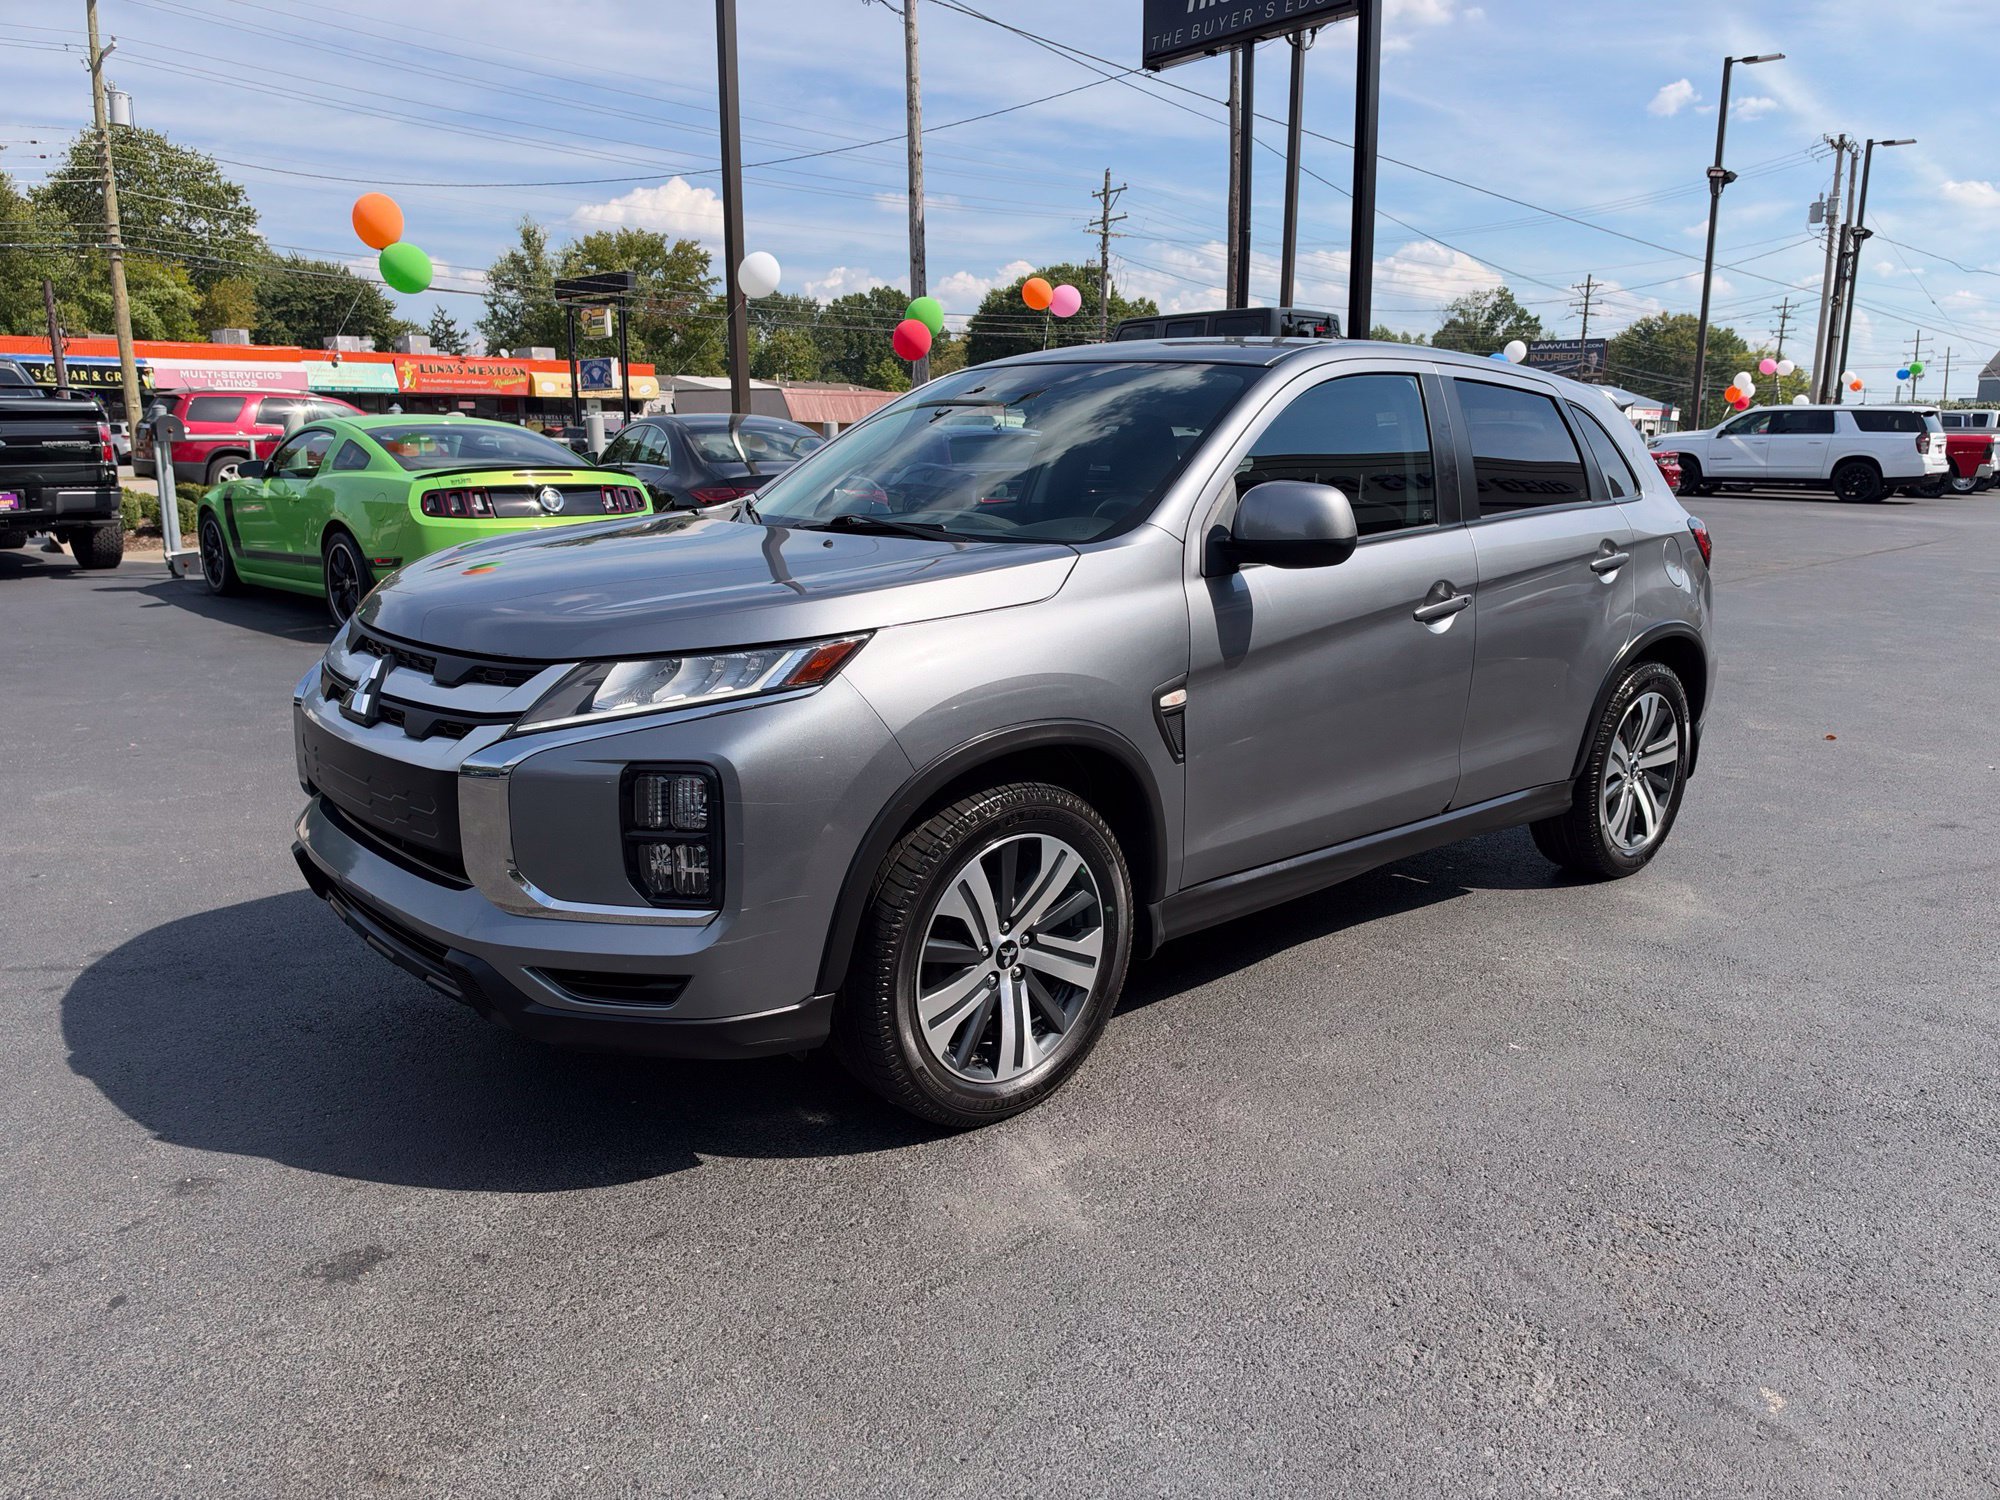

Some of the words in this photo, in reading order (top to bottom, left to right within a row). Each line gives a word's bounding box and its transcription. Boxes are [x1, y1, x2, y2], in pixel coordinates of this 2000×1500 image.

[1152, 28, 1183, 51] THE
[1191, 1, 1275, 40] BUYER'S
[180, 370, 282, 380] MULTI-SERVICIOS
[419, 363, 464, 376] LUNA'S
[467, 365, 526, 377] MEXICAN
[207, 379, 258, 388] LATINOS
